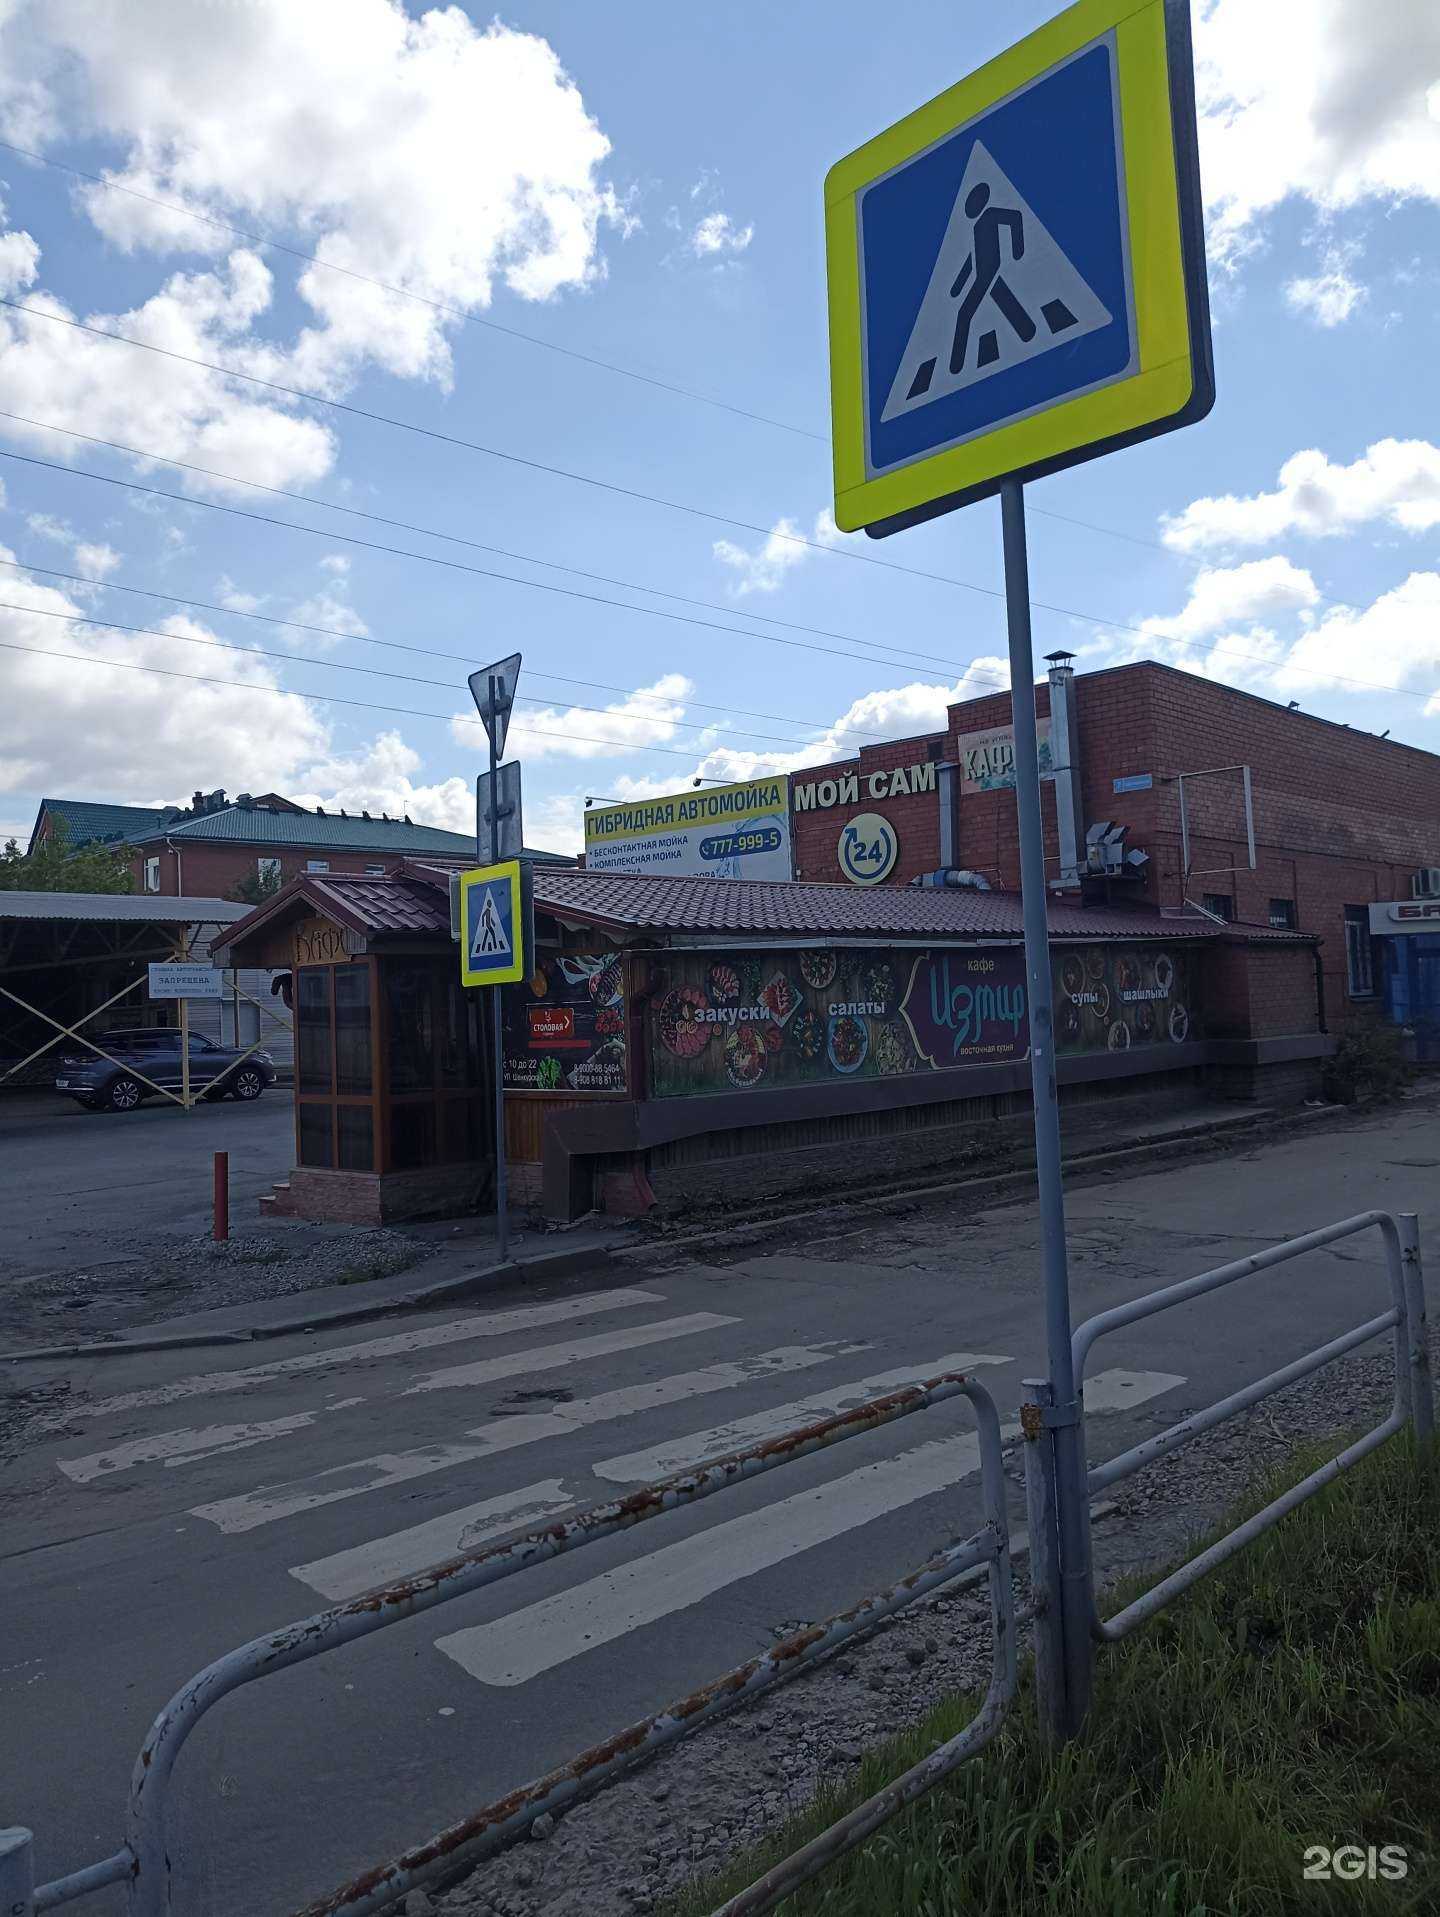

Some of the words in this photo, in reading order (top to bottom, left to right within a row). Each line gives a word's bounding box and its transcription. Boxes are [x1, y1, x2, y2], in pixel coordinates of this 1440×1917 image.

[964, 744, 1015, 781] КАФ
[795, 771, 859, 812] МОЙ
[868, 762, 936, 800] САМ
[587, 807, 674, 836] ГИБРИДНАЯ
[678, 784, 781, 823] АВТОМОЙКА
[594, 840, 658, 858] БЕСКОНТАКТНАЯ
[658, 836, 689, 849] МОЙКА
[710, 831, 778, 855] 777-999-5
[853, 840, 882, 863] 24
[594, 855, 651, 869] КОМПЛЕКСНАЯ
[652, 849, 682, 862] МОЙКА
[967, 956, 994, 975] кафе
[158, 977, 210, 985] ЗАПРЕЩЕНА
[1071, 992, 1099, 1007] супы
[1122, 987, 1169, 1001] шашлыки
[695, 1006, 770, 1026] закуски
[828, 1001, 885, 1017] салаты
[533, 1024, 564, 1032] СТОЛОВАЯ
[960, 1046, 995, 1056] восточная
[528, 1059, 538, 1069] 22
